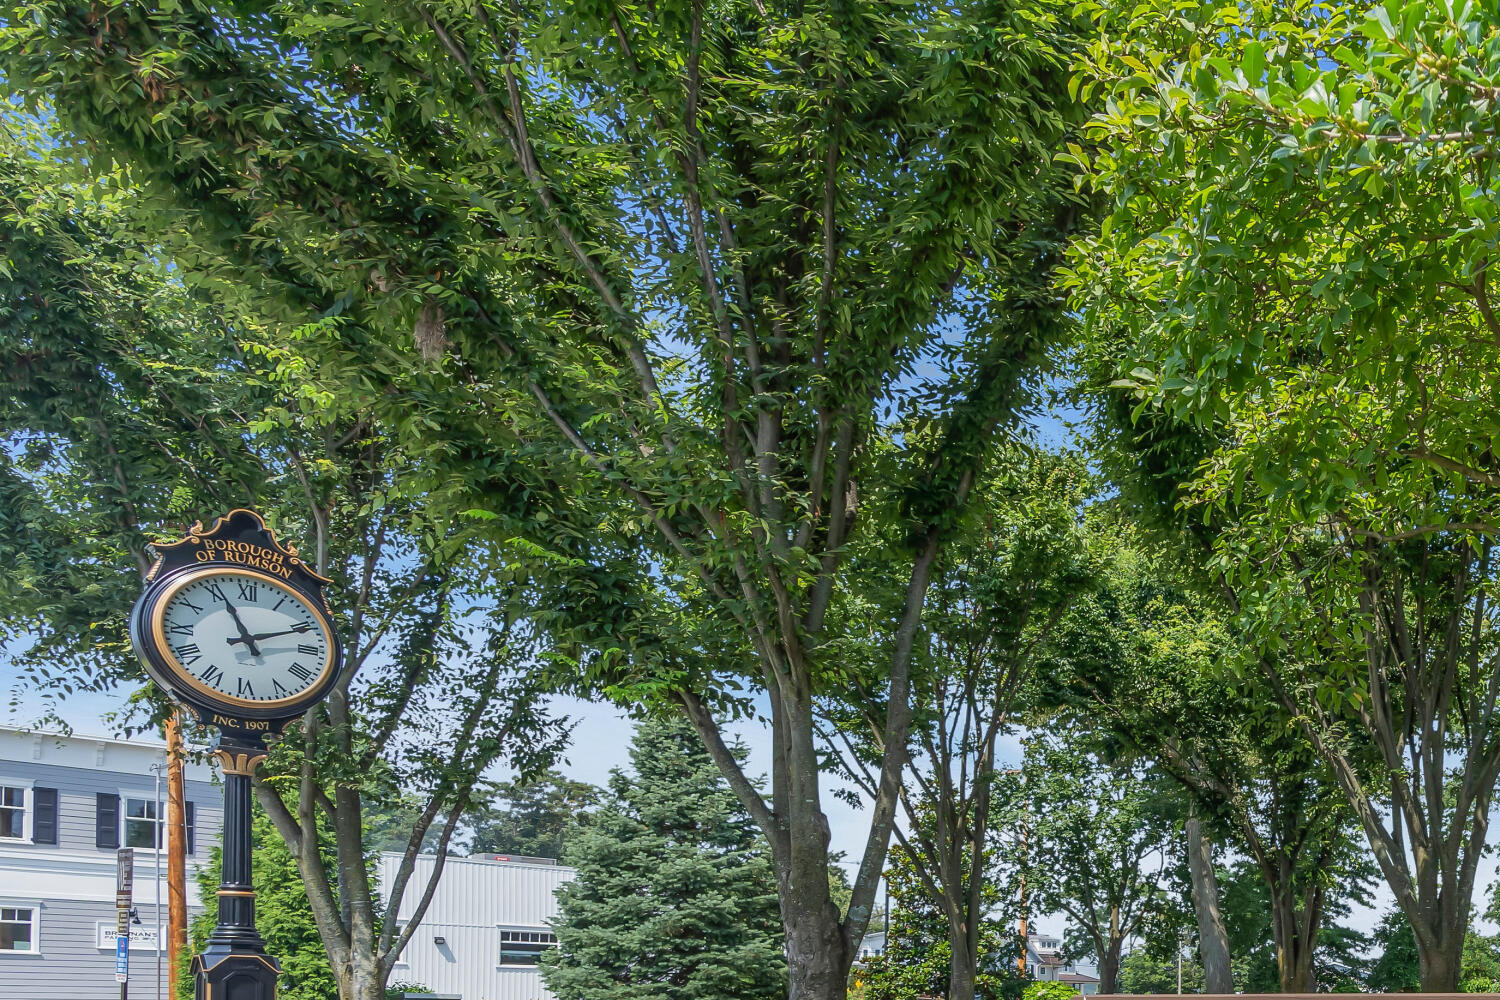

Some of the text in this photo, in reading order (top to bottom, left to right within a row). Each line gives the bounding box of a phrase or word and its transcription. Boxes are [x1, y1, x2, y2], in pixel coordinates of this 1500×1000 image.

[203, 539, 284, 564] BOROUGH
[196, 550, 292, 578] OF RUMSON
[238, 583, 257, 602] XII
[179, 597, 204, 615] X
[170, 620, 194, 634] IX
[176, 643, 203, 666] VIII
[298, 644, 318, 656] III
[200, 664, 224, 686] VII
[238, 677, 254, 696] VI
[272, 677, 287, 694] V
[213, 714, 269, 730] INC. 1907
